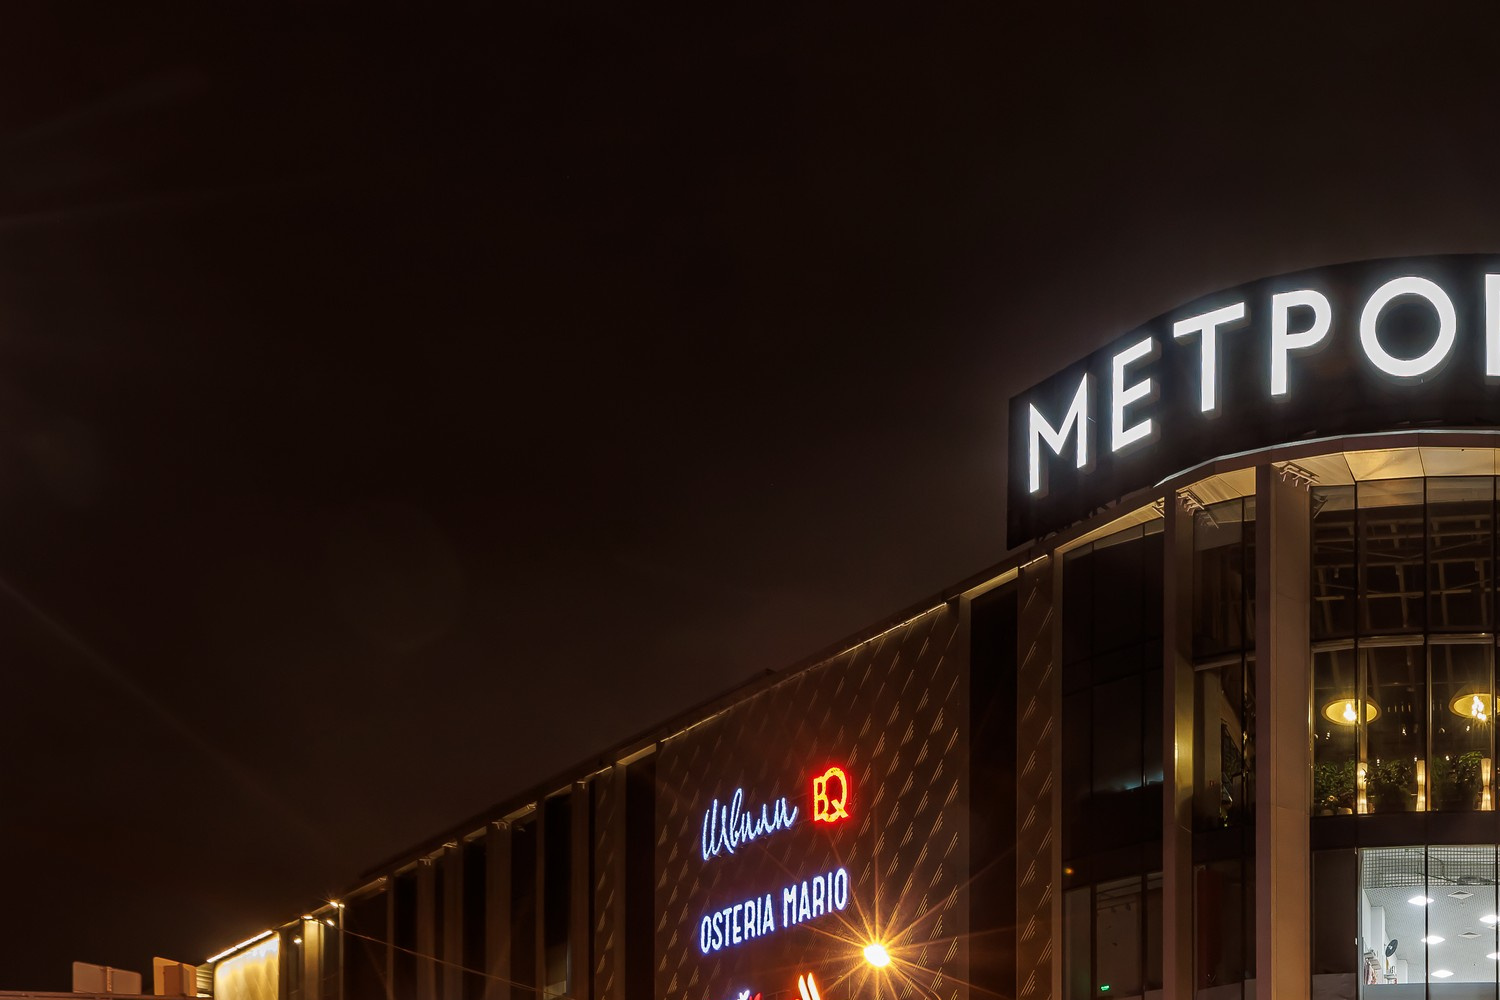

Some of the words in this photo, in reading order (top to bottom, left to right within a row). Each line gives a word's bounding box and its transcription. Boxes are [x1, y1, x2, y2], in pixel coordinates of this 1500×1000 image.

[813, 767, 848, 822] BQ
[700, 893, 775, 954] OSTERIA
[783, 867, 848, 928] MARIO
